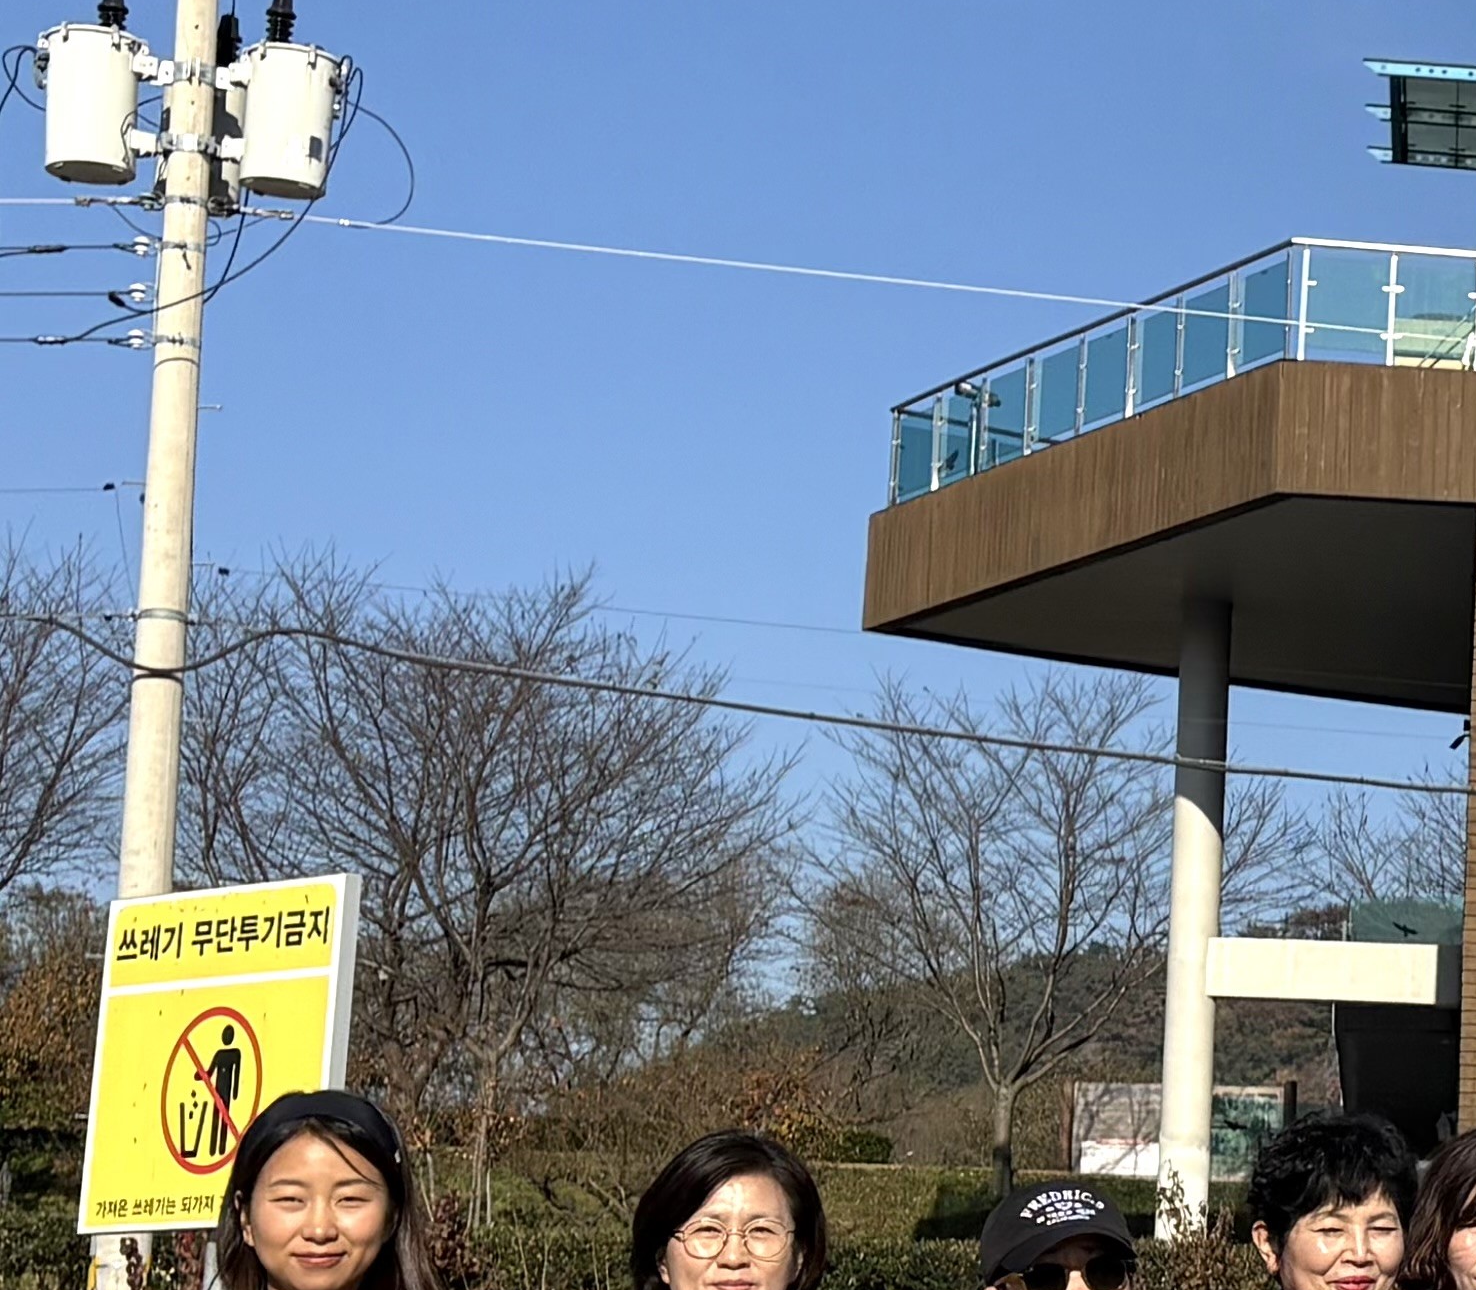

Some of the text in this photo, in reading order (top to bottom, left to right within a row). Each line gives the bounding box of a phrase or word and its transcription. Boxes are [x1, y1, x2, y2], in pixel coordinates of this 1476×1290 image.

[117, 906, 330, 961] 쓰레기 무단투기금지
[132, 1195, 177, 1216] 쓰레기는
